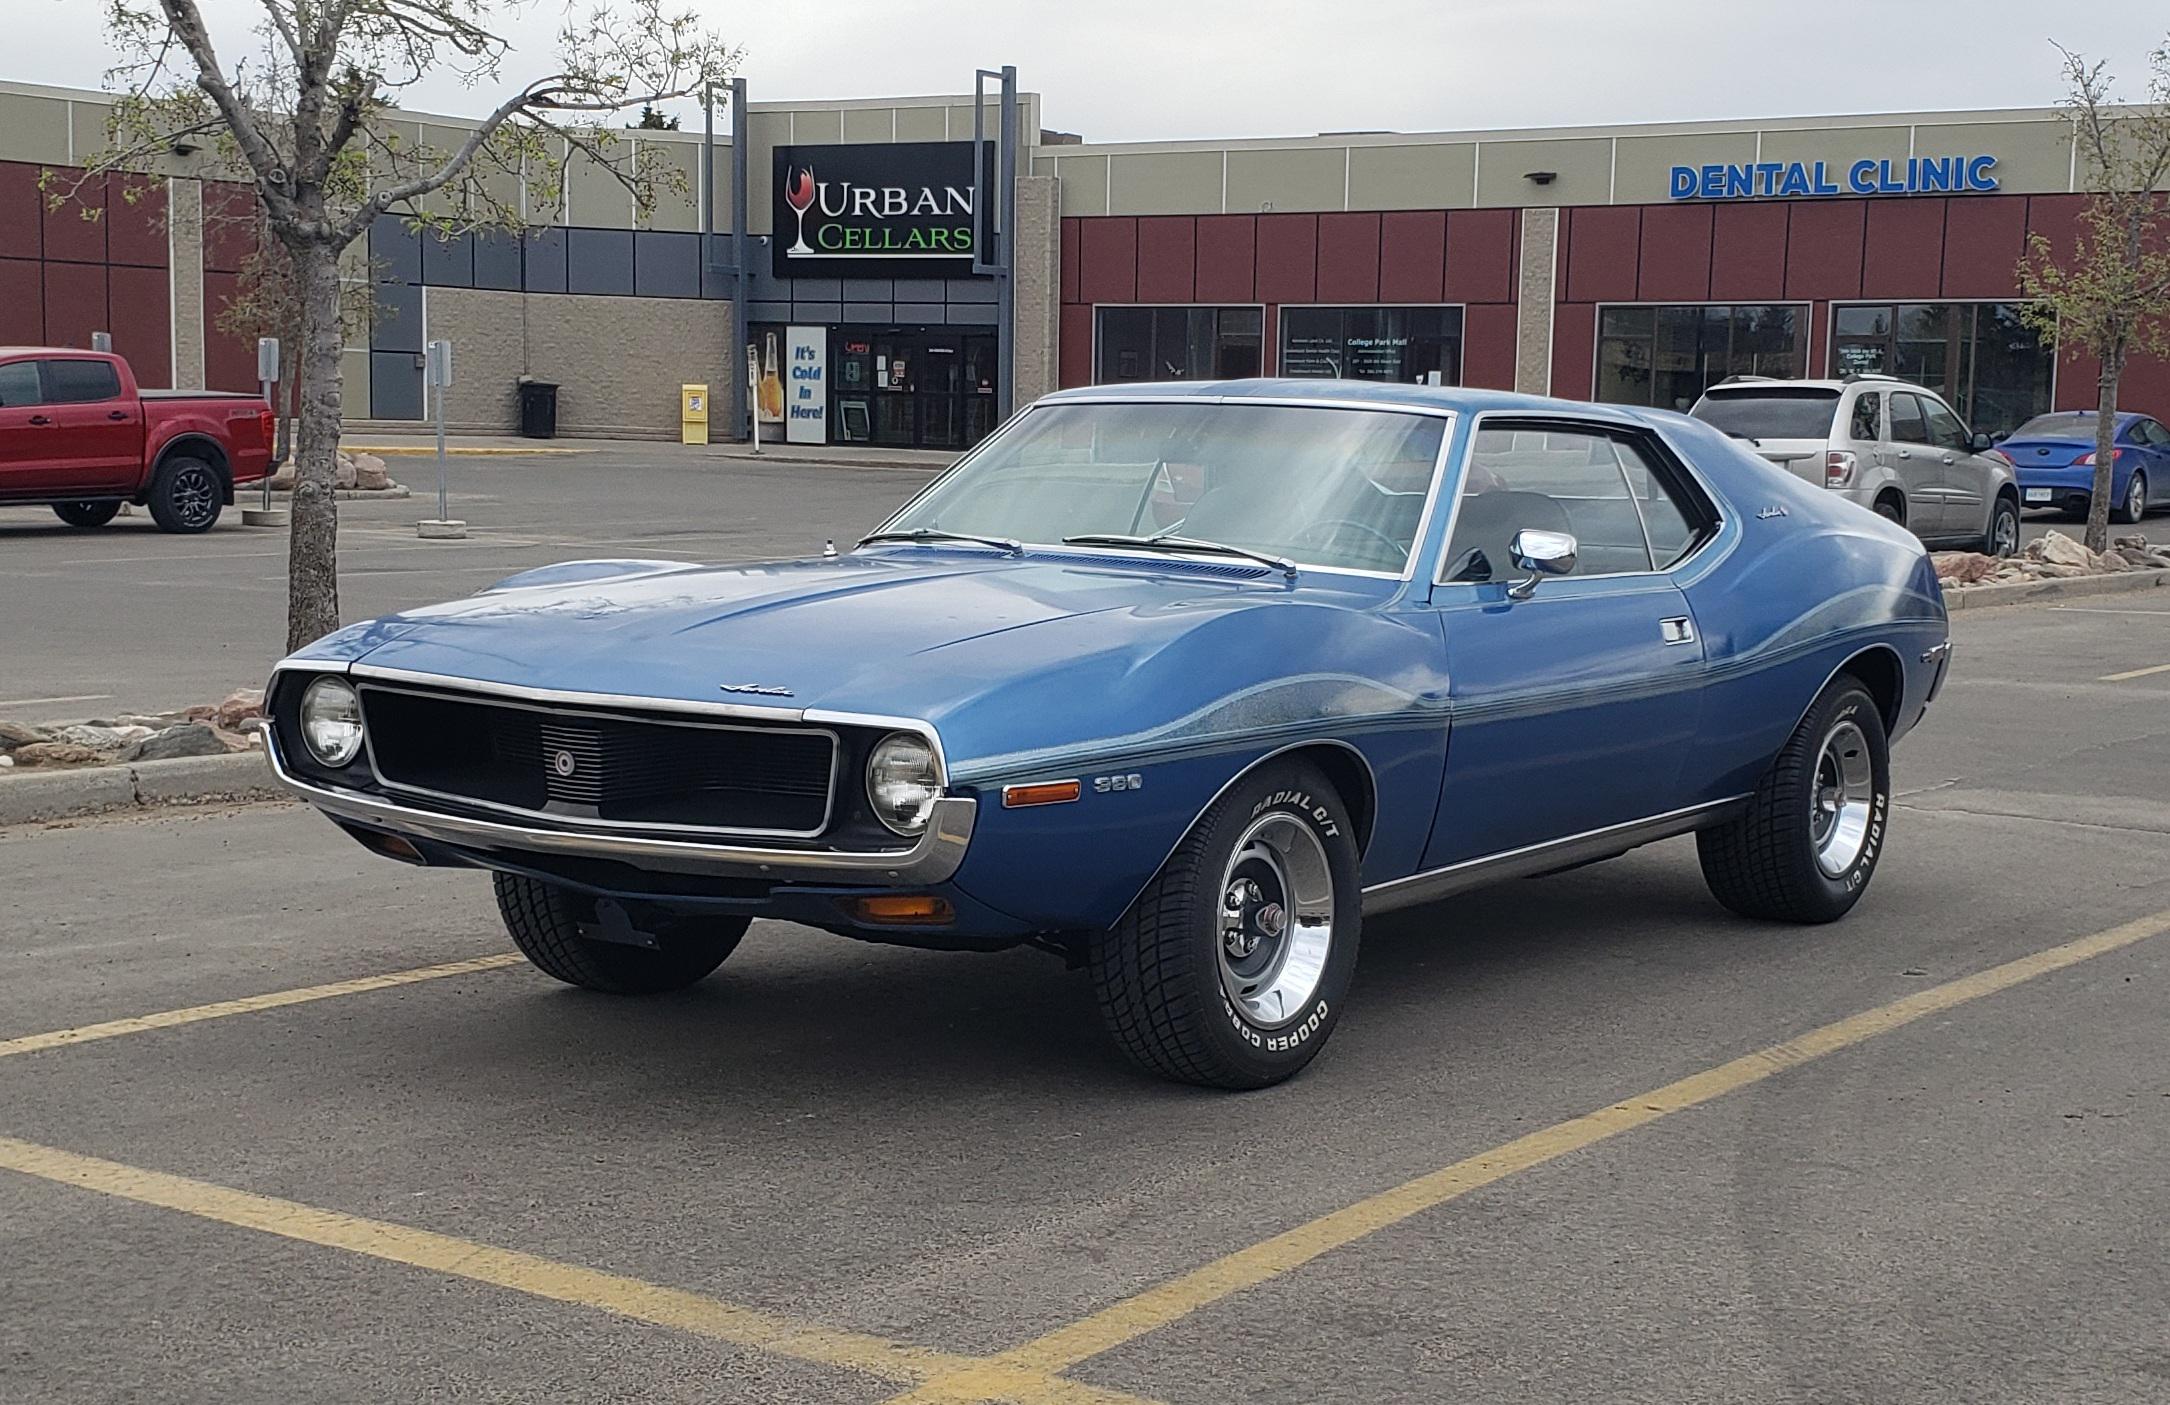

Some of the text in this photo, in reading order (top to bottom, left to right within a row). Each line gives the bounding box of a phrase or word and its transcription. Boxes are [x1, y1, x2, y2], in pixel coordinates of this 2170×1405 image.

[1669, 155, 1999, 199] DENTAL CLINIC
[816, 182, 975, 219] URBAN
[818, 223, 972, 251] CELLARS
[795, 345, 816, 360] It's
[1347, 338, 1408, 347] College Park Mall
[792, 366, 822, 380] Cold
[790, 404, 824, 419] Here!
[1250, 790, 1340, 836] RADIAL G/T
[1860, 792, 1885, 867] RADIAL
[1267, 1000, 1328, 1052] COOPER
